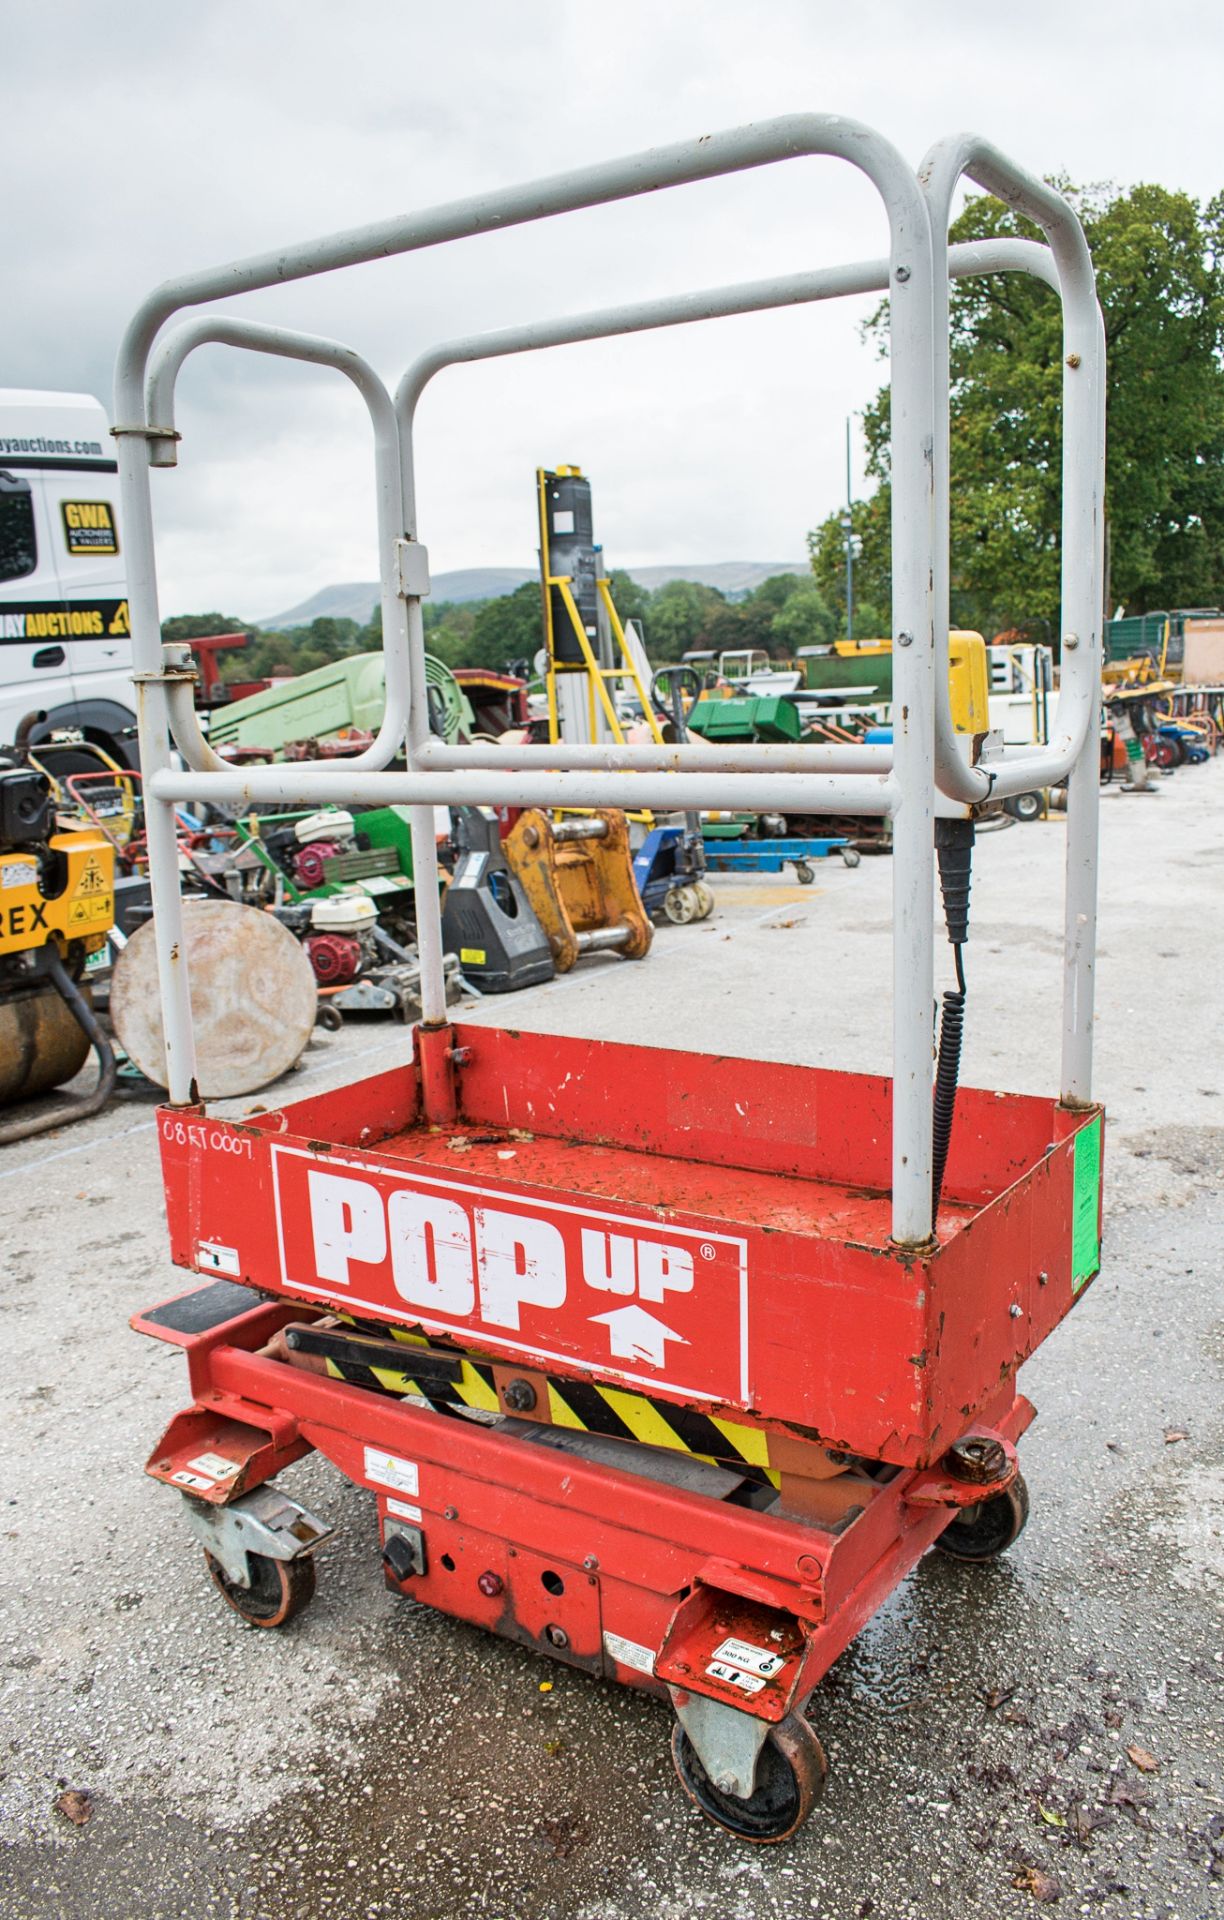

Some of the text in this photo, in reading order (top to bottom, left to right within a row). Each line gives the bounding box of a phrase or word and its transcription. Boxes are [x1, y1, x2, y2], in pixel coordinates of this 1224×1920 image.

[65, 504, 111, 528] GWA
[0, 611, 104, 639] AYAUCTIONS
[0, 901, 48, 938] EX
[307, 1169, 567, 1331] POP
